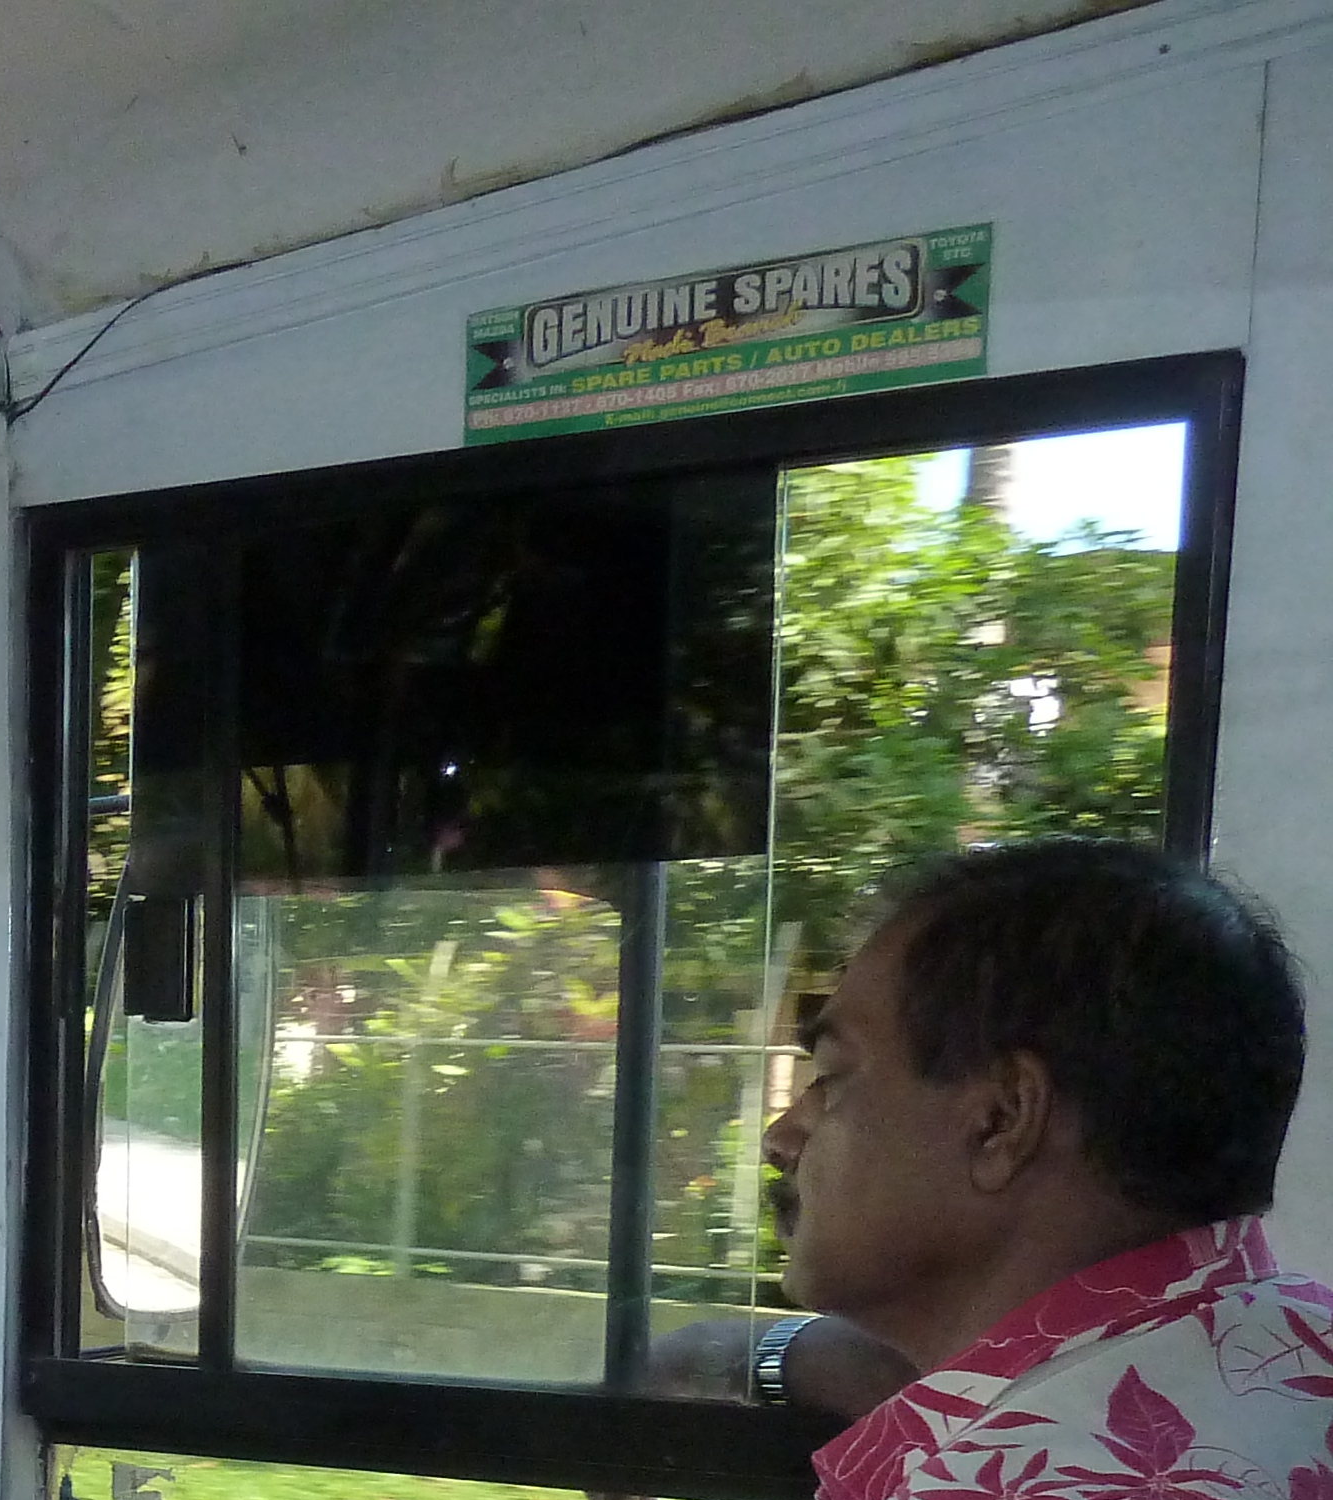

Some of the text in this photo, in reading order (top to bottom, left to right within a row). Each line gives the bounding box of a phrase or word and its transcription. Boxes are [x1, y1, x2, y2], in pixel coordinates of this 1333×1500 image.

[469, 386, 546, 404] SPECIALISTS
[571, 367, 651, 393] SPARE
[660, 353, 743, 381] PARTS
[767, 339, 842, 364] AUTO
[851, 316, 982, 351] DEALERS
[532, 249, 912, 368] GENUINE SPARES
